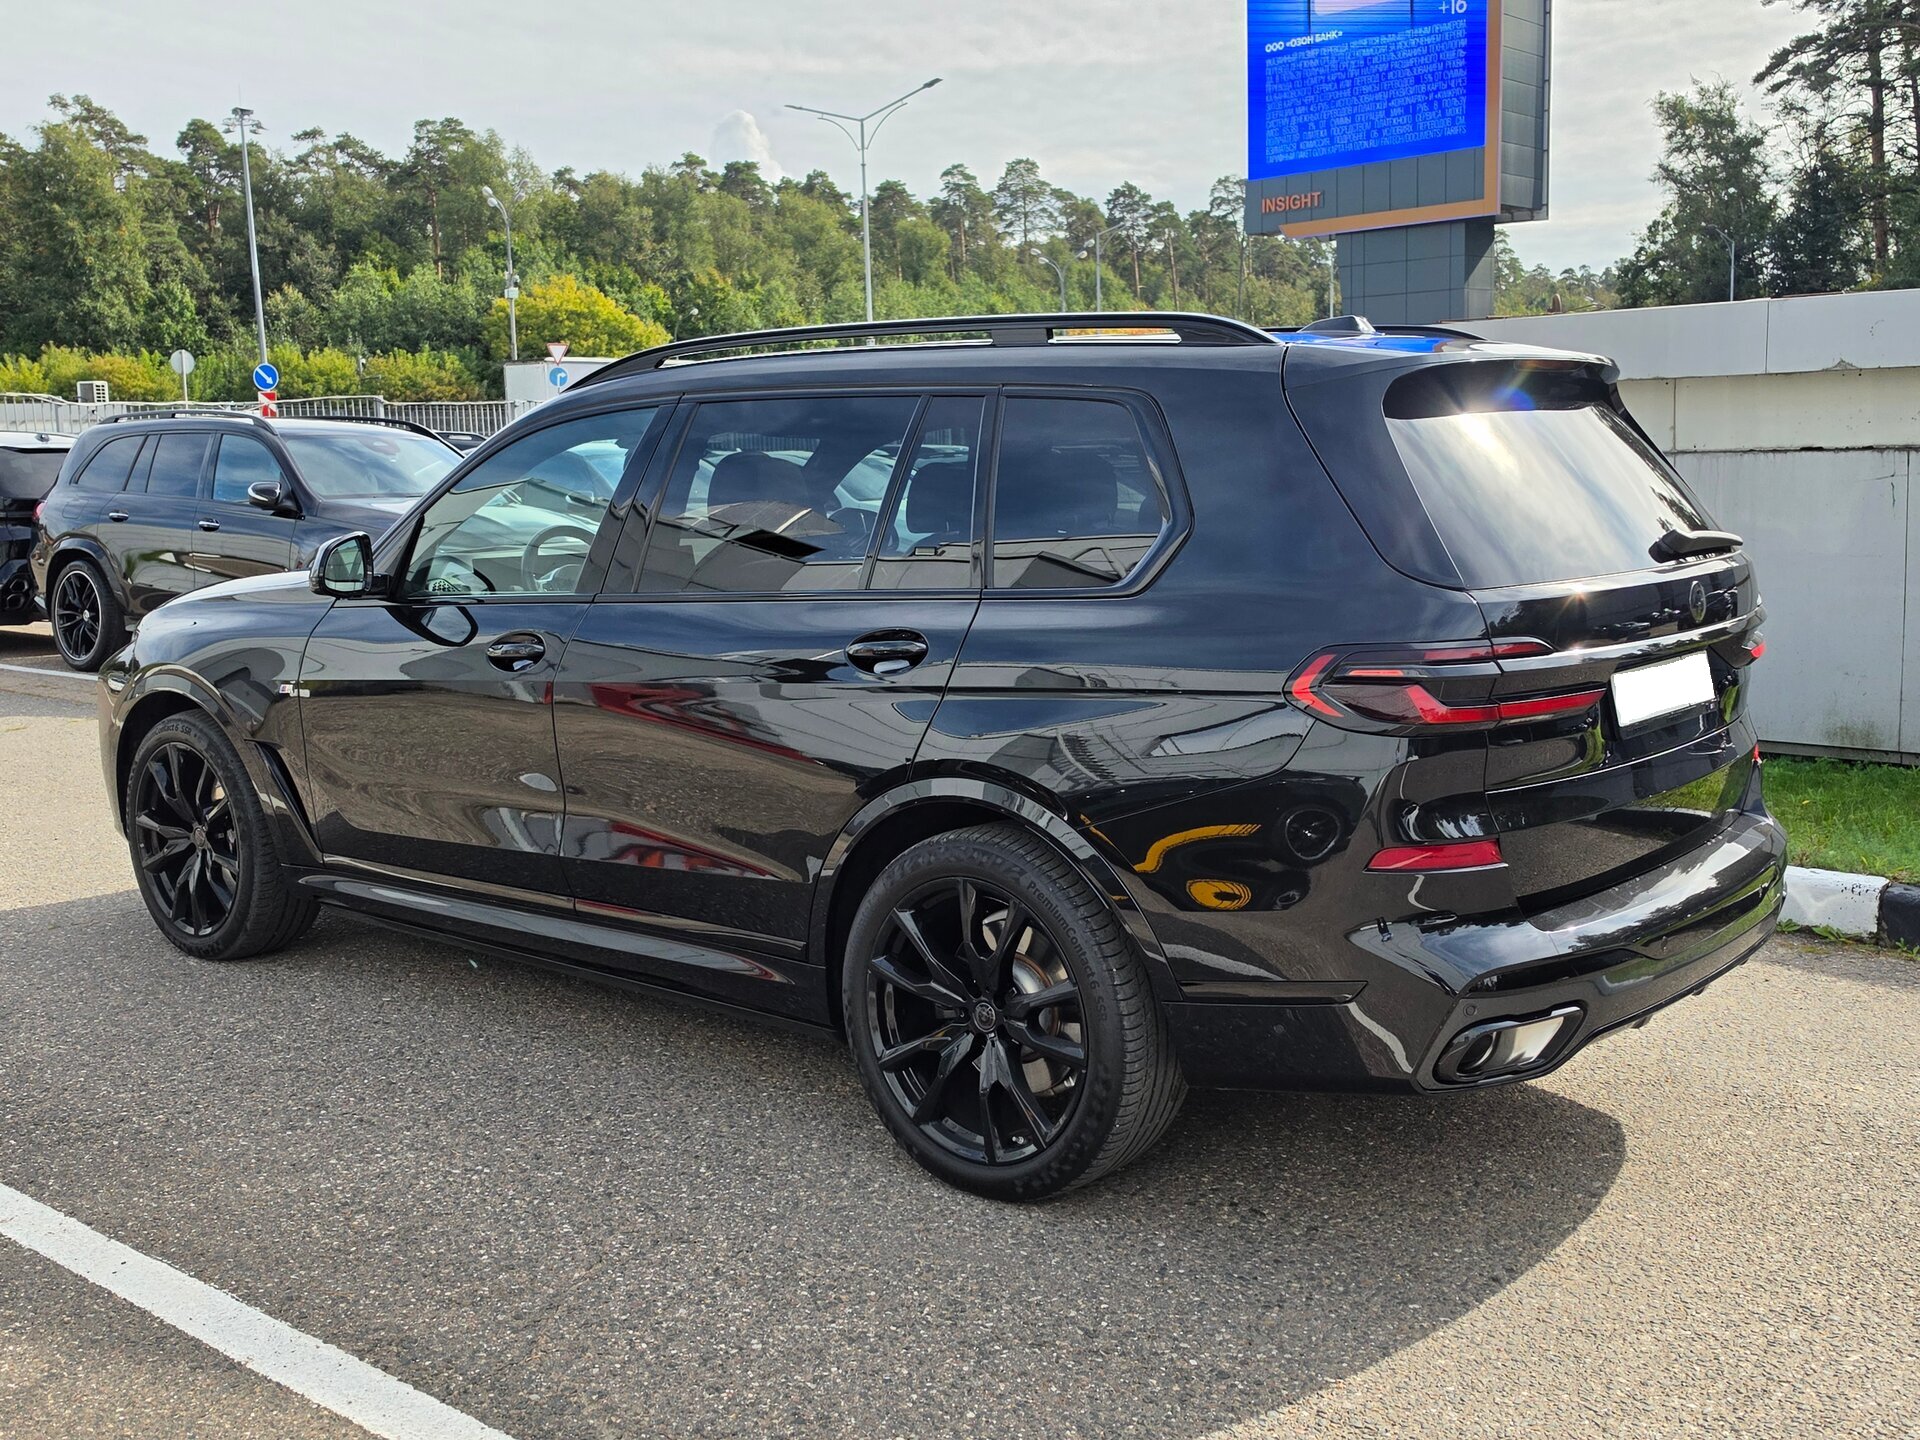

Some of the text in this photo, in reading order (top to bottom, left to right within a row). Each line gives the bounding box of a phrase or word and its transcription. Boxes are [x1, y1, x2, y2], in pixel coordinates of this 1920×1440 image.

[1265, 30, 1343, 53] ООО «ОЗОН БАНК»
[1262, 192, 1321, 213] INSIGHT
[1026, 880, 1096, 980] PremiumContact
[1089, 981, 1100, 990] 6
